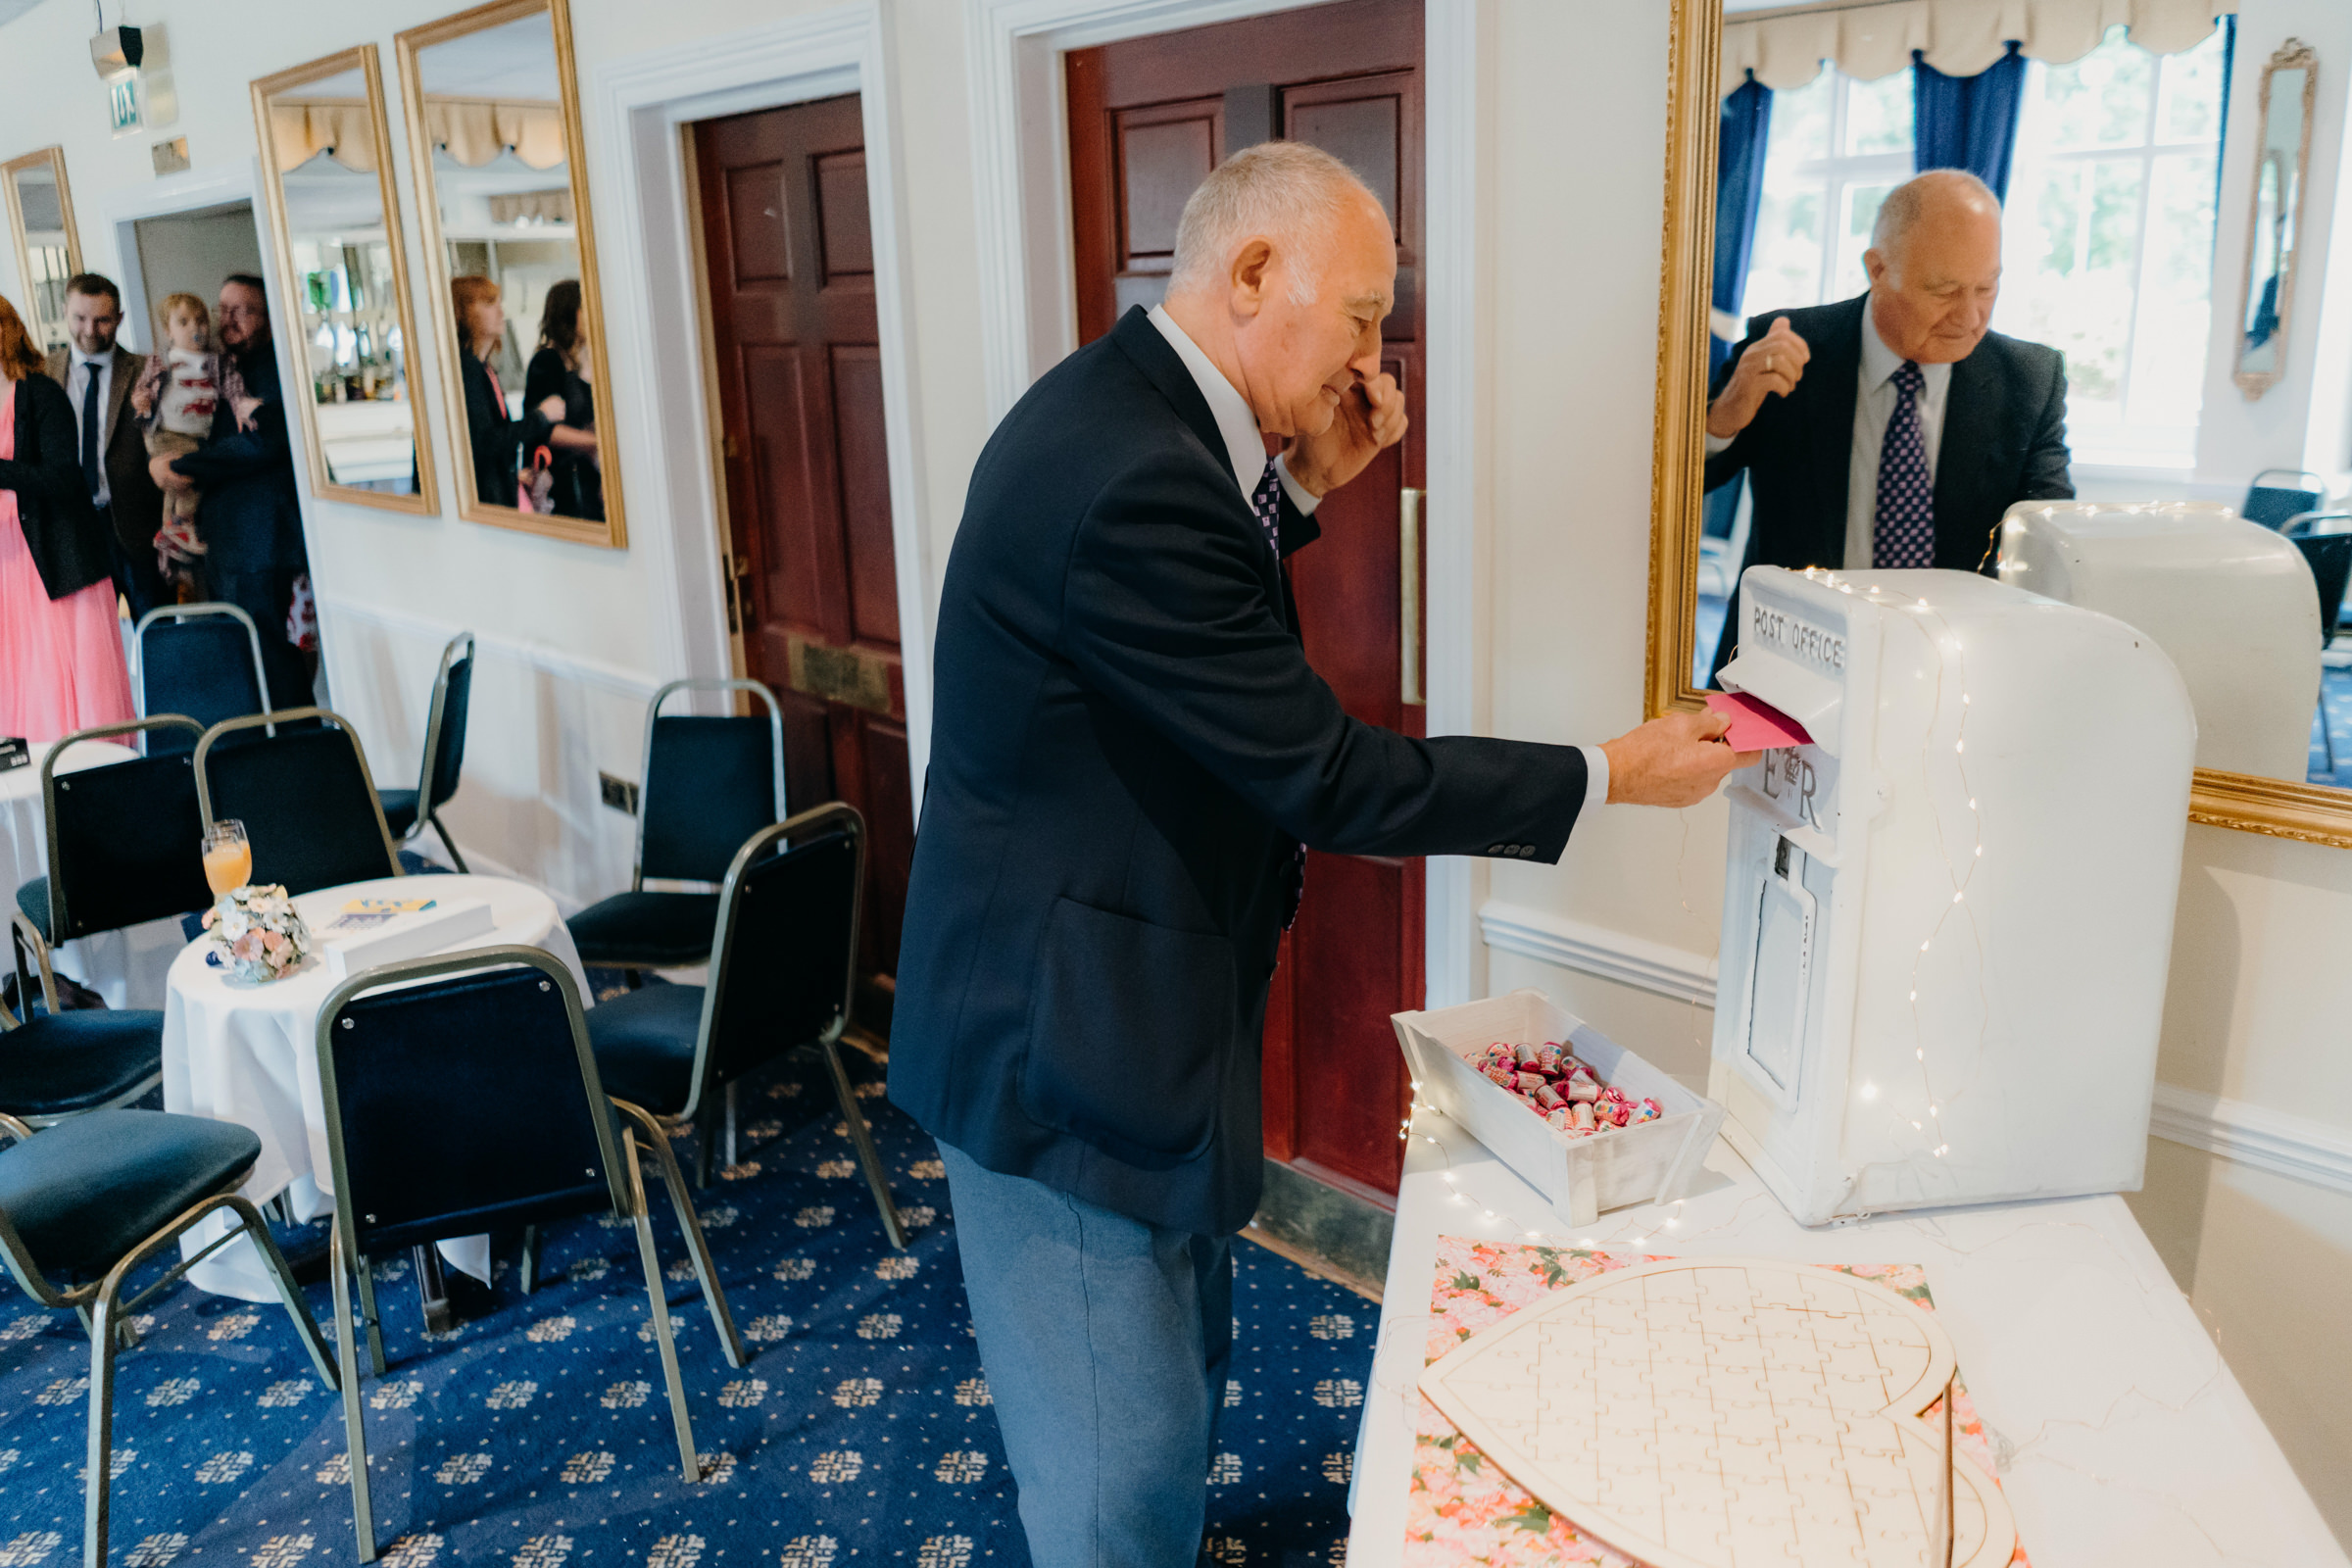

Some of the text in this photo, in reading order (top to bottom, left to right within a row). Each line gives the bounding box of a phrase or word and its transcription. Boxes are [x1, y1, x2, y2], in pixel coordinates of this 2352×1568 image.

[1754, 606, 1842, 668] POST OFFICE
[1798, 760, 1821, 830] R
